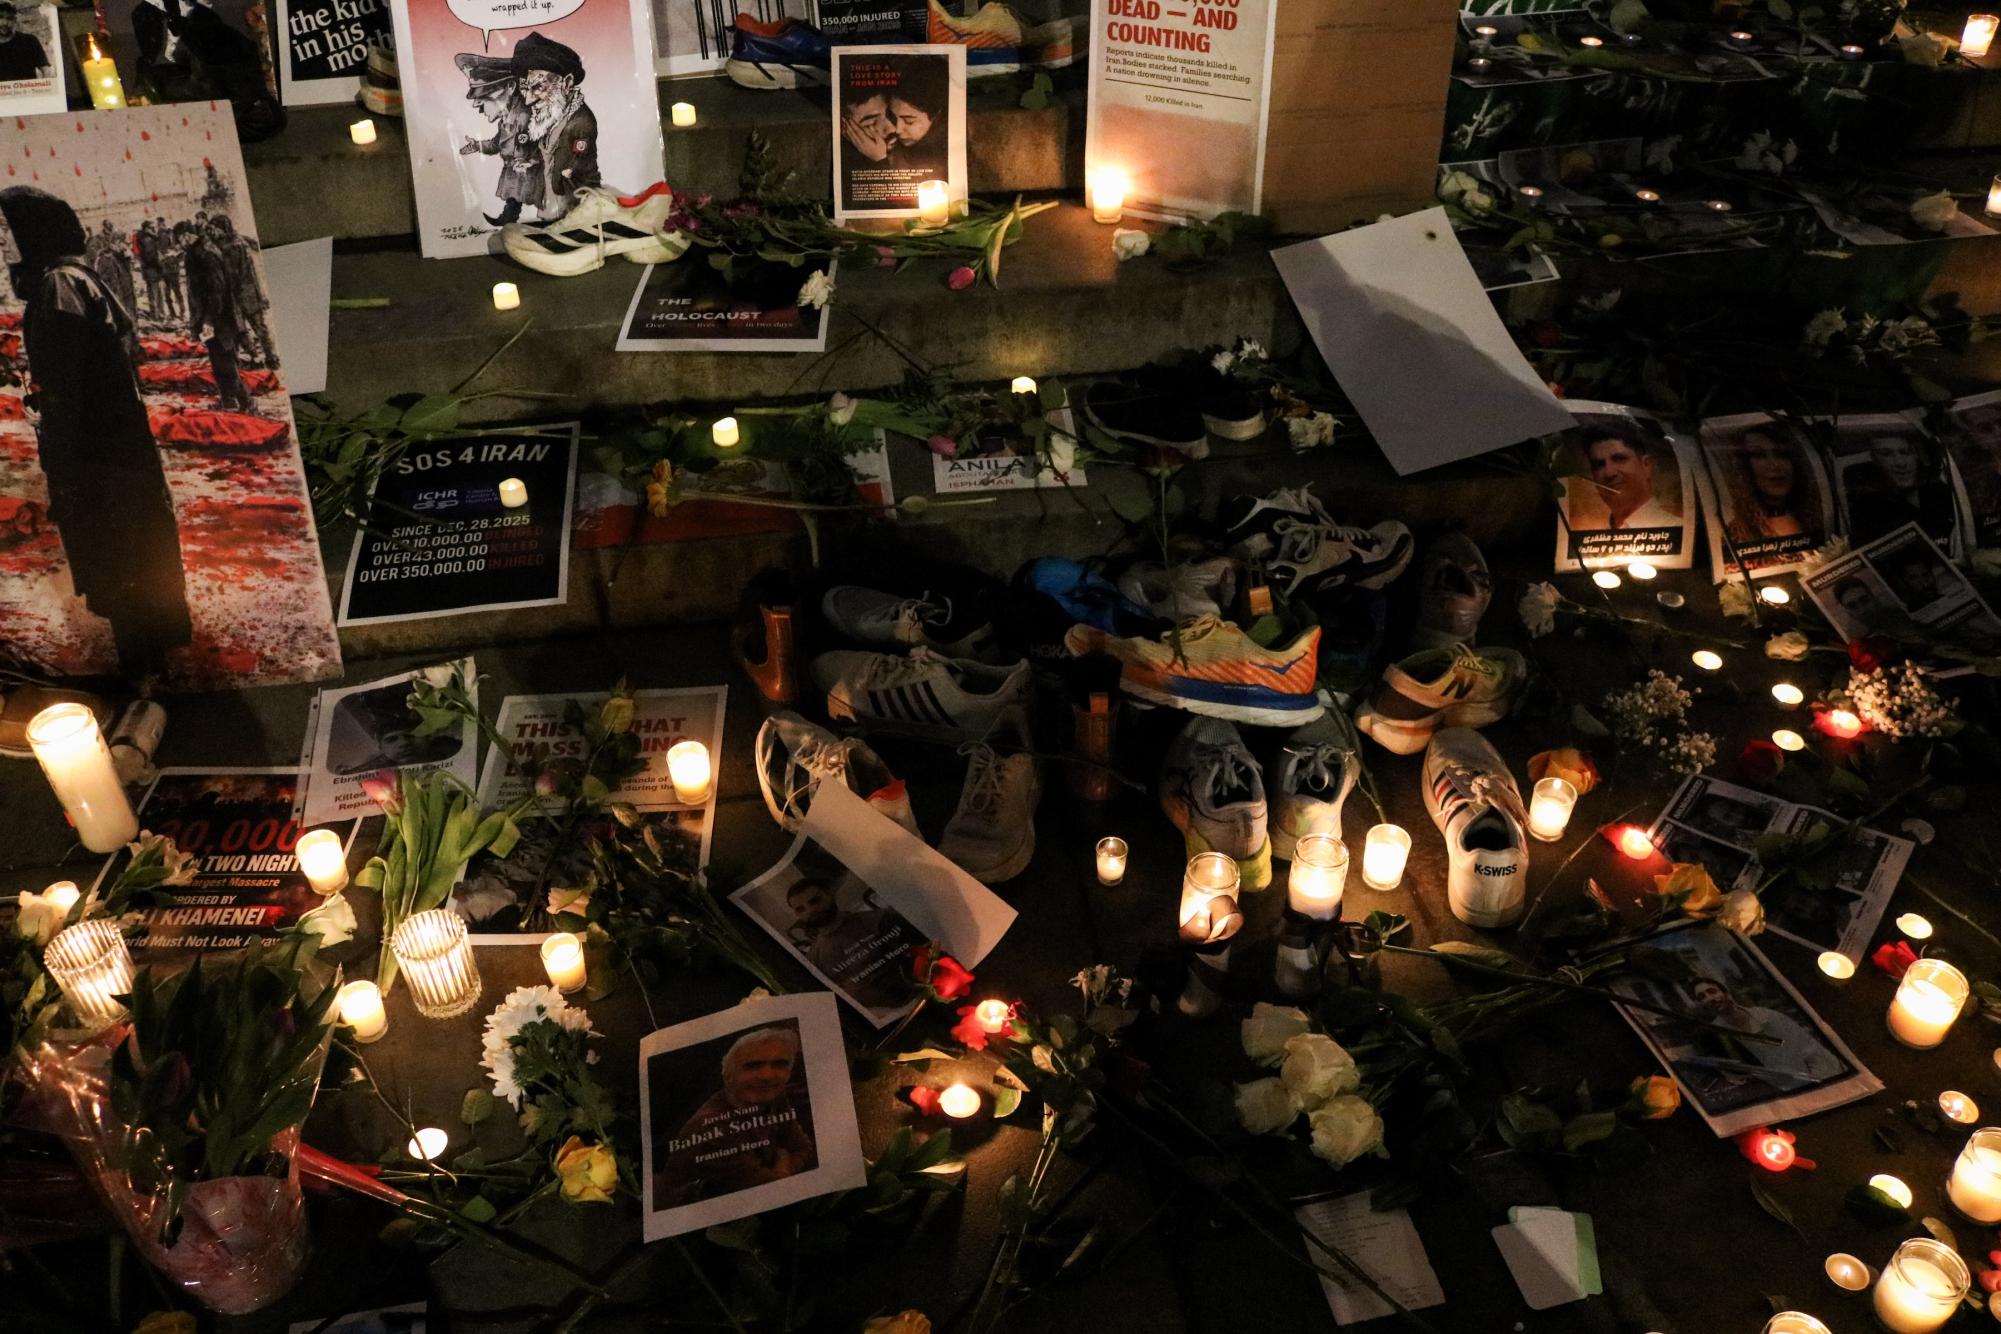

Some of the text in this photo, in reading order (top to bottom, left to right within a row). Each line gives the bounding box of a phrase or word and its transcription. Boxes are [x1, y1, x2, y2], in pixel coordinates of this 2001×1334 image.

[491, 1, 555, 17] wrapped it up.
[1108, 0, 1160, 20] DEAD
[1193, 7, 1238, 31] AND
[290, 8, 331, 36] the
[822, 15, 859, 26] 350,000
[860, 11, 901, 23] INJURED
[291, 22, 366, 62] in his
[1107, 21, 1211, 54] COUNTING
[1106, 46, 1237, 71] Reports indicate thousands killed in
[1105, 65, 1112, 73] A
[1113, 67, 1136, 77] nation
[1137, 70, 1172, 84] drowning
[1182, 77, 1211, 88] silence.
[1148, 62, 1177, 73] stacked.
[1180, 66, 1212, 78] Families
[1213, 73, 1252, 85] searching.
[1144, 94, 1165, 104] 12,000
[1166, 97, 1183, 107] Killed
[657, 298, 693, 306] THE
[650, 311, 762, 321] HOLOCAUST
[396, 443, 551, 475] SOS 4 IRAN
[948, 457, 1026, 473] ANILA
[418, 489, 458, 501] ICHR
[391, 524, 432, 539] SINCE
[470, 514, 531, 531] 28.2025
[413, 531, 483, 549] 10.000.00
[372, 552, 411, 567] OVER
[359, 568, 398, 583] OVER
[400, 558, 486, 579] 350.000.00
[1811, 558, 1863, 589] MURDERED
[515, 721, 573, 739] THIS
[624, 783, 658, 792] during
[205, 855, 245, 872] TWO
[191, 876, 281, 889] argest Massacre
[220, 895, 237, 905] BY
[160, 908, 267, 926] KHAMENEI
[124, 935, 150, 947] orld
[150, 936, 181, 947] Must
[184, 935, 208, 947] Not
[210, 935, 241, 947] Look
[850, 943, 910, 984] Iranian Hero
[702, 1104, 759, 1127] Javid Nam
[668, 1107, 797, 1153] Babak Soltani
[694, 1138, 771, 1164] Iranian Hero
